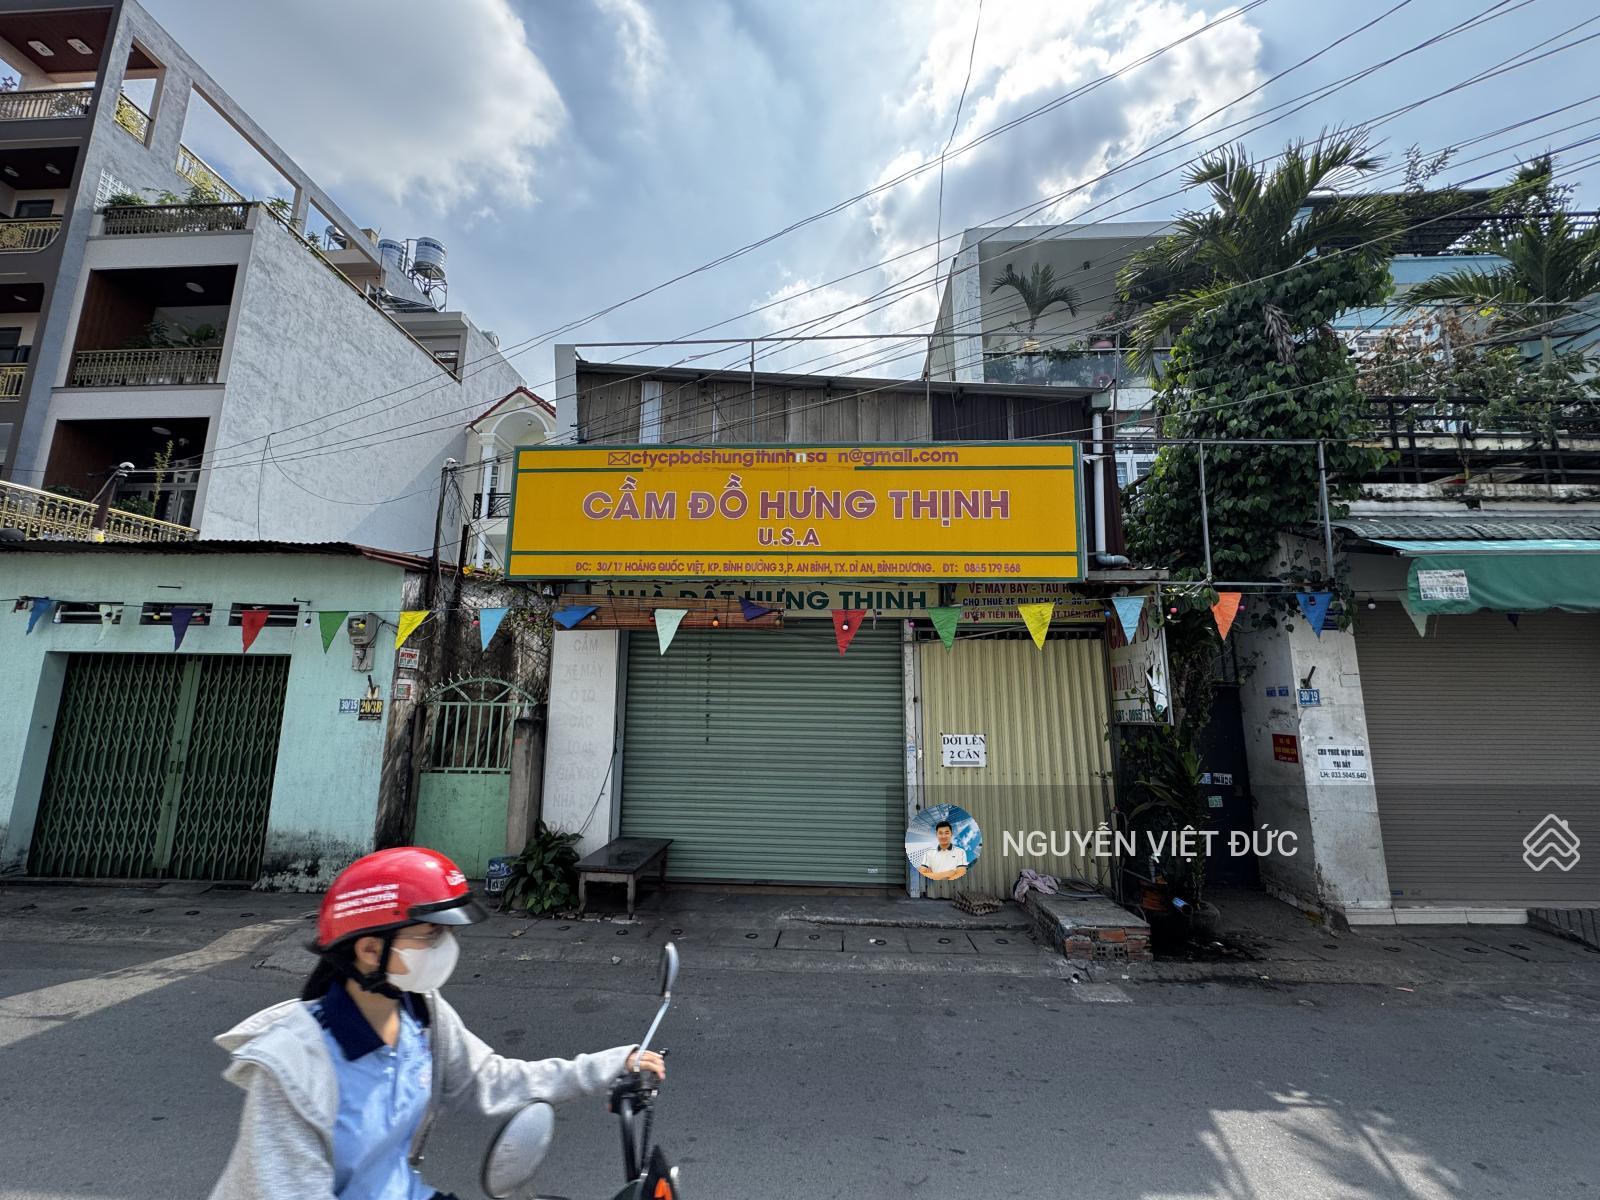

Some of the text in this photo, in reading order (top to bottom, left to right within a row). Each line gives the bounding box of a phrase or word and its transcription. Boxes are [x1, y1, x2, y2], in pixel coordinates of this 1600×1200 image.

[582, 473, 1010, 527] CẦM ĐỒ HƯNG THỊNH
[757, 526, 822, 547] U.S.A
[658, 559, 685, 572] QUỐC
[687, 560, 706, 574] VIỆT,
[797, 562, 809, 573] AN
[988, 562, 1002, 573] 179
[1010, 583, 1029, 594] BAY
[950, 749, 980, 759] 2 CĂN
